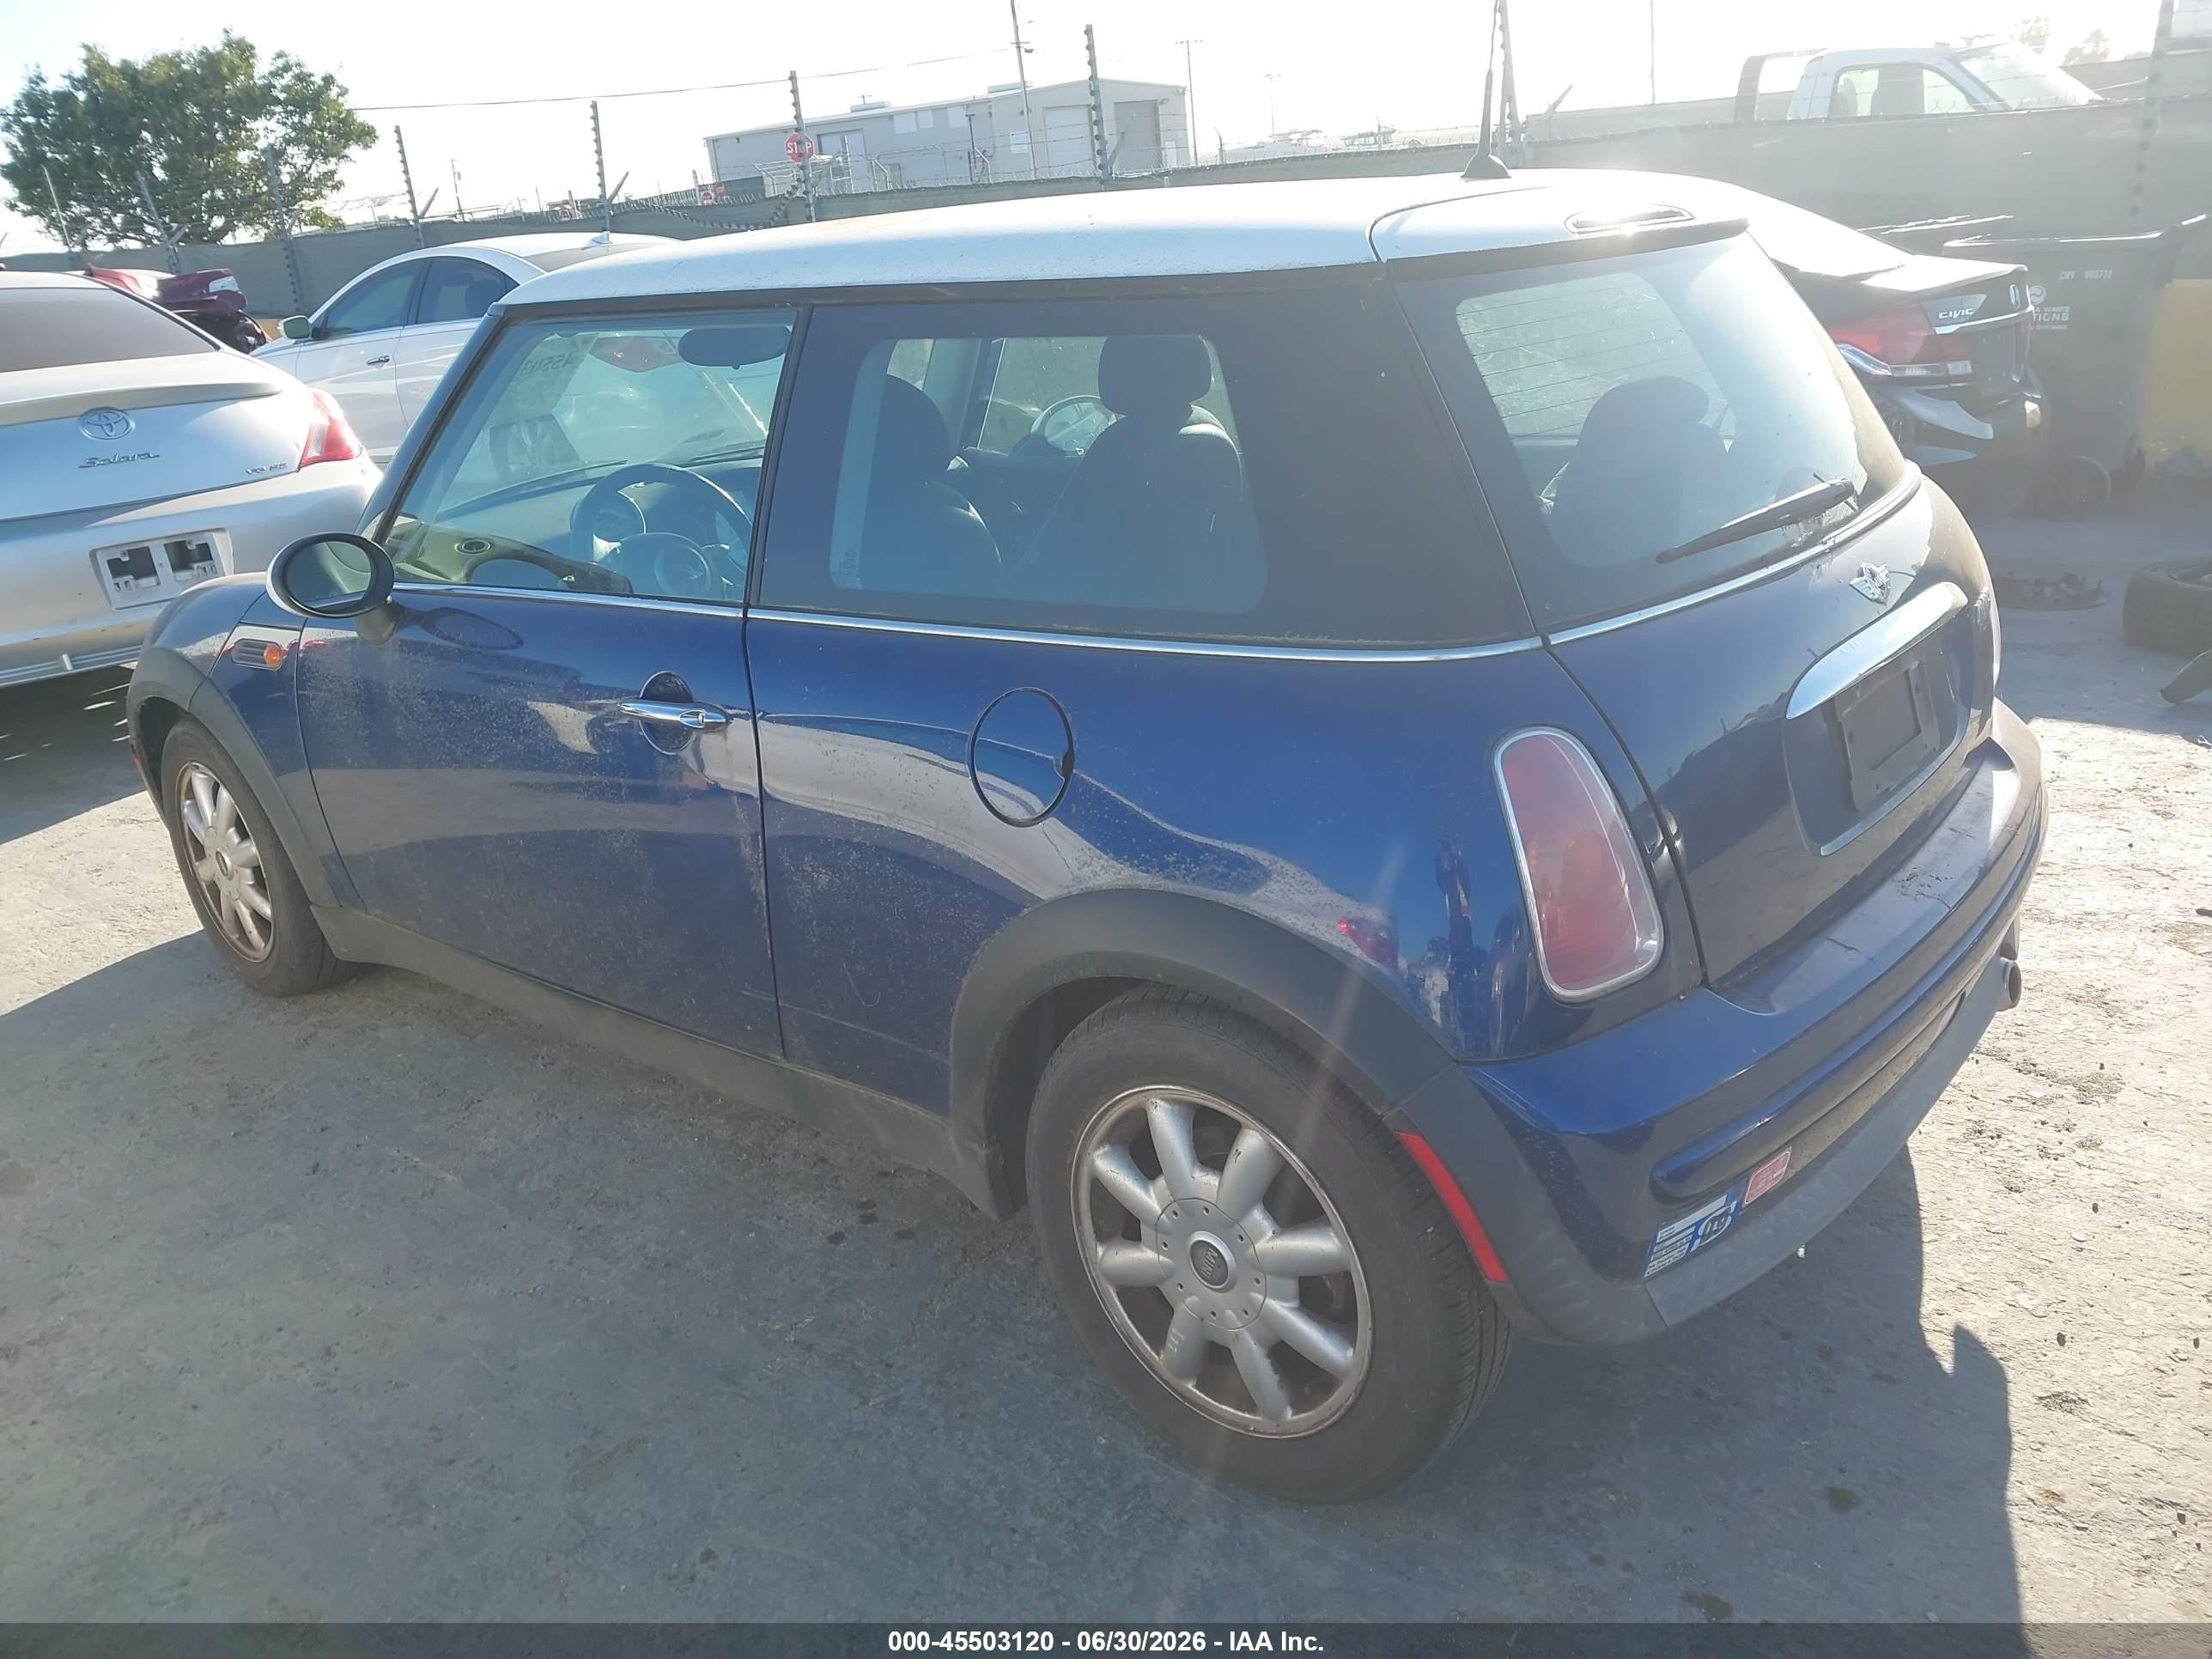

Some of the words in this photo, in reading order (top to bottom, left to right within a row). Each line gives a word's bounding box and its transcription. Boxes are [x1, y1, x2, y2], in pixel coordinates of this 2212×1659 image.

[787, 142, 811, 155] STP
[1938, 308, 1974, 319] CIVIC
[78, 453, 161, 469] Solara
[1200, 1248, 1218, 1279] MINI
